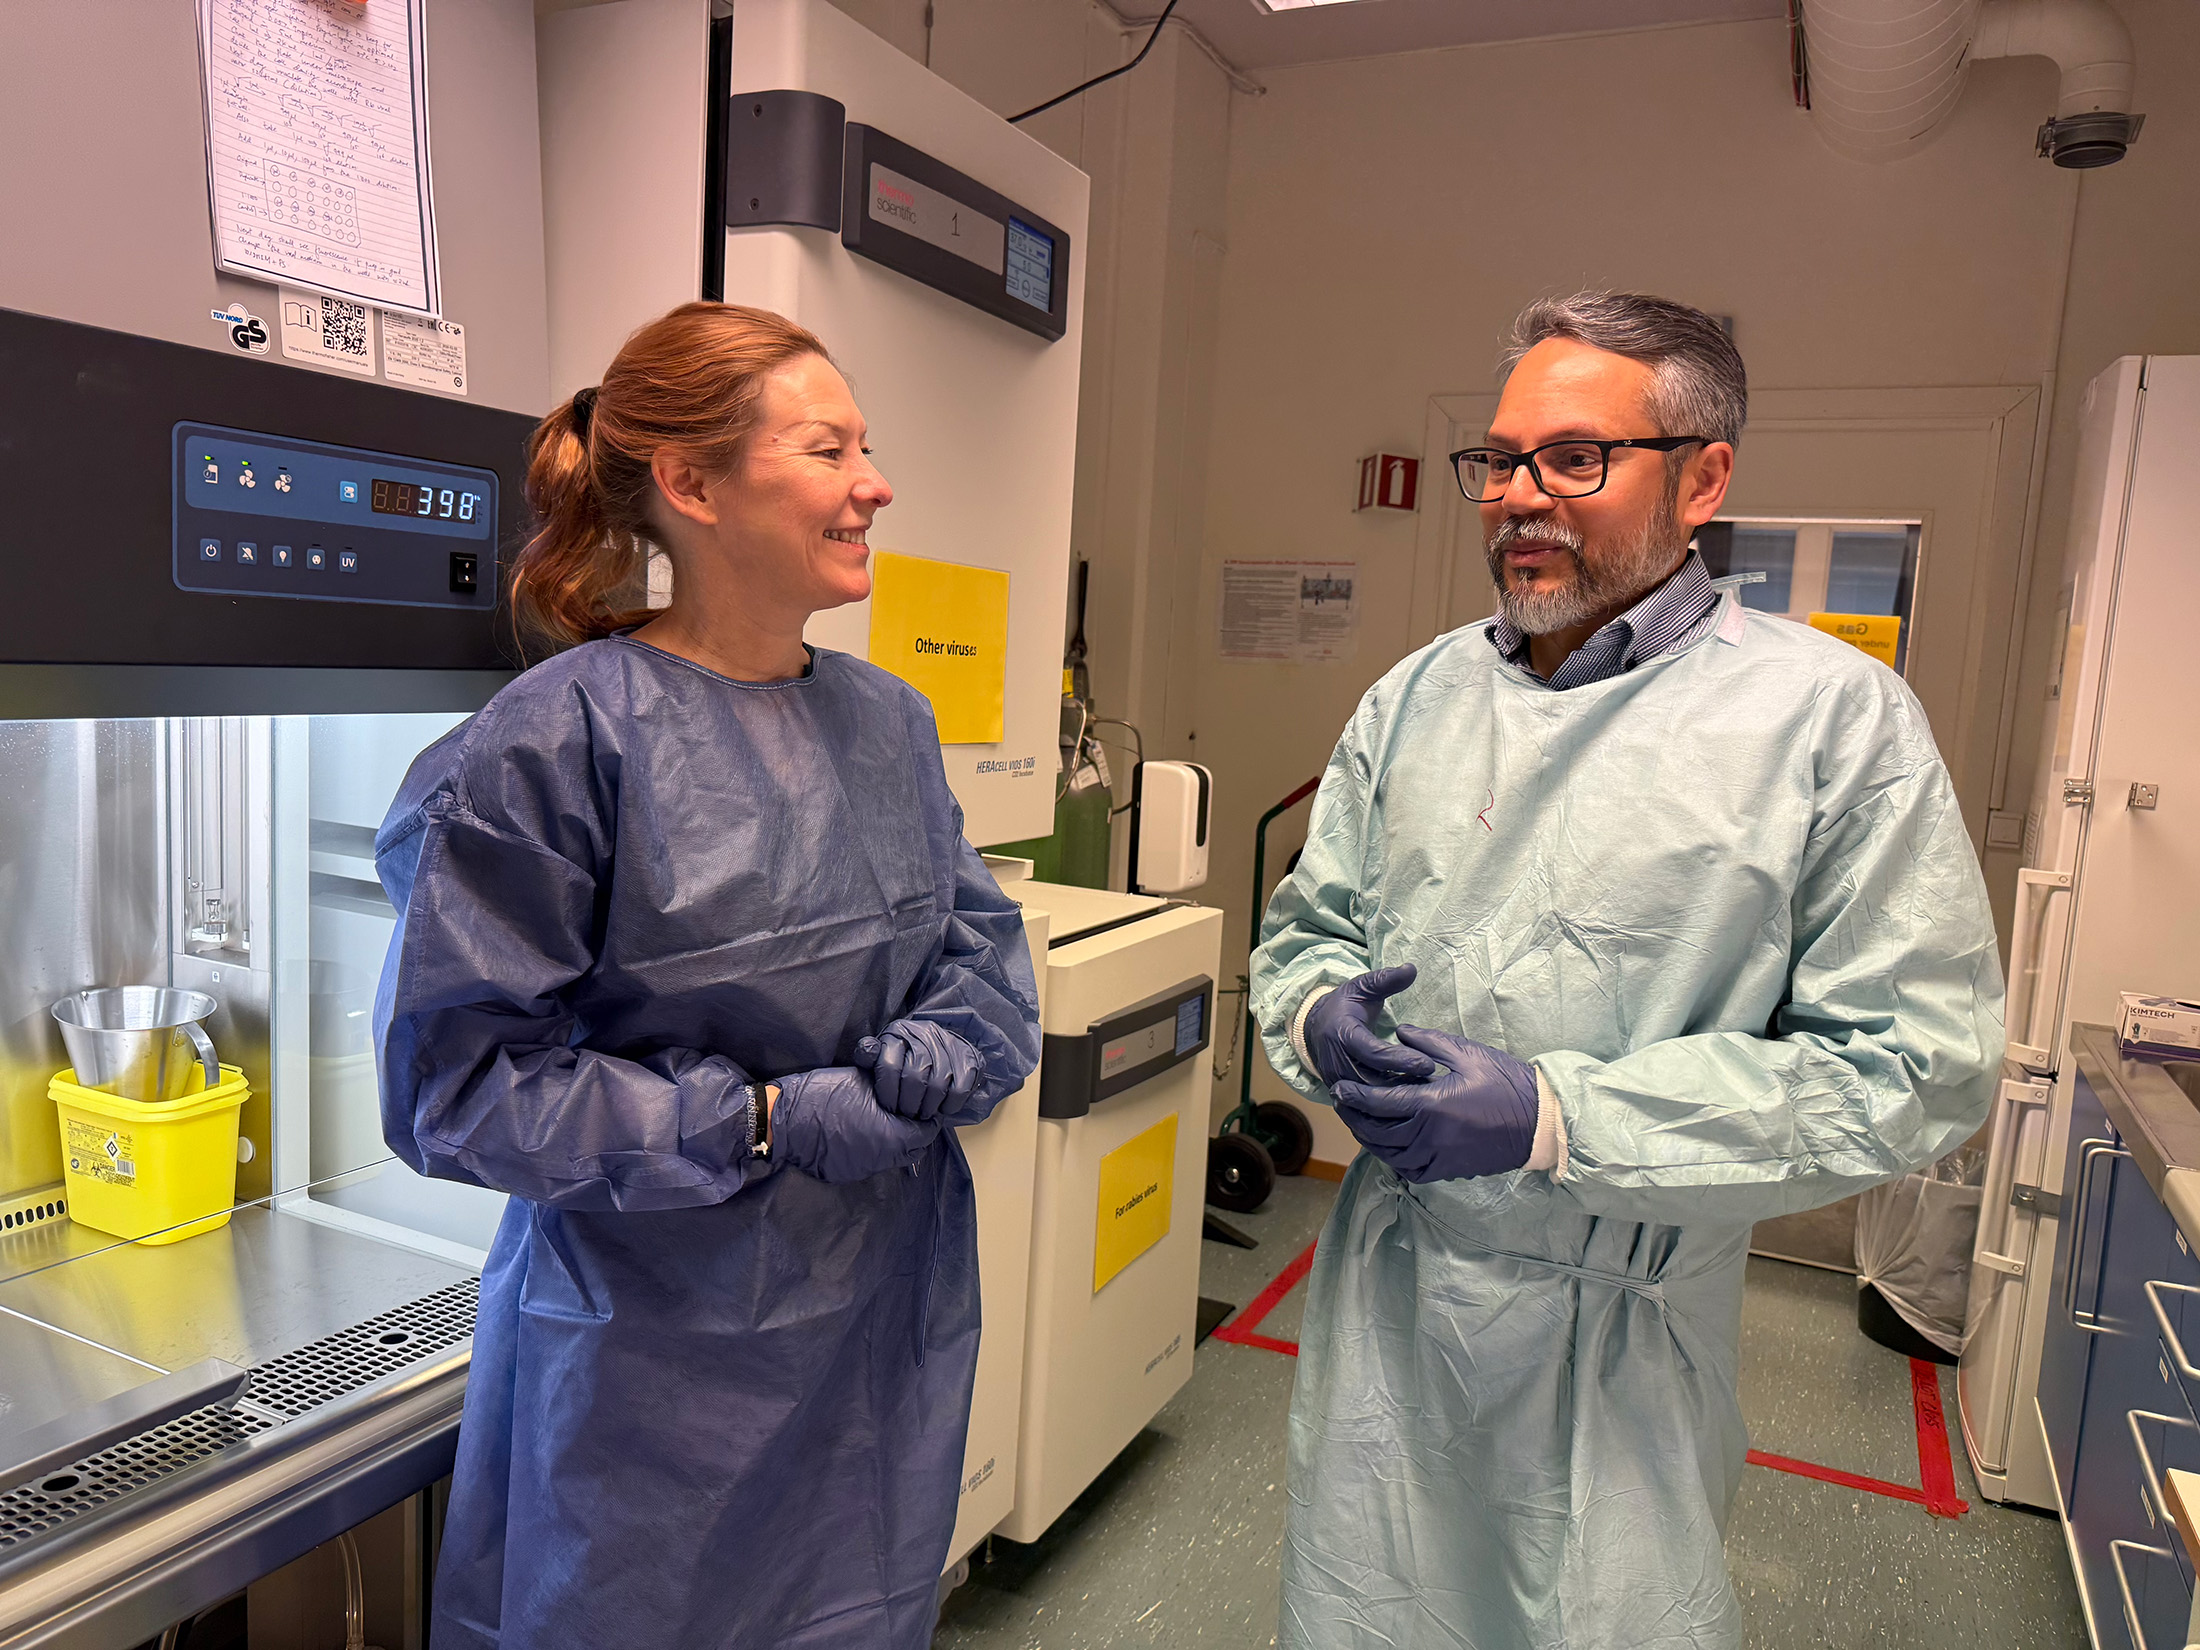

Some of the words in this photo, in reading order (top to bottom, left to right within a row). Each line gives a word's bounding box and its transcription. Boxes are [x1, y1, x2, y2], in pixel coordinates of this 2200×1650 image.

[876, 197, 917, 225] scientific
[951, 212, 961, 237] 1
[225, 314, 243, 323] NORD
[232, 319, 267, 350] GS
[418, 486, 474, 520] 398
[341, 557, 355, 569] UV
[915, 637, 944, 655] Other
[946, 640, 977, 657] viruses
[1008, 758, 1022, 771] VIOS
[1022, 756, 1036, 770] 160i
[2129, 1007, 2175, 1019] KIMTECH
[1115, 1207, 1125, 1219] For
[1125, 1191, 1144, 1213] rabies
[1144, 1182, 1158, 1198] virus
